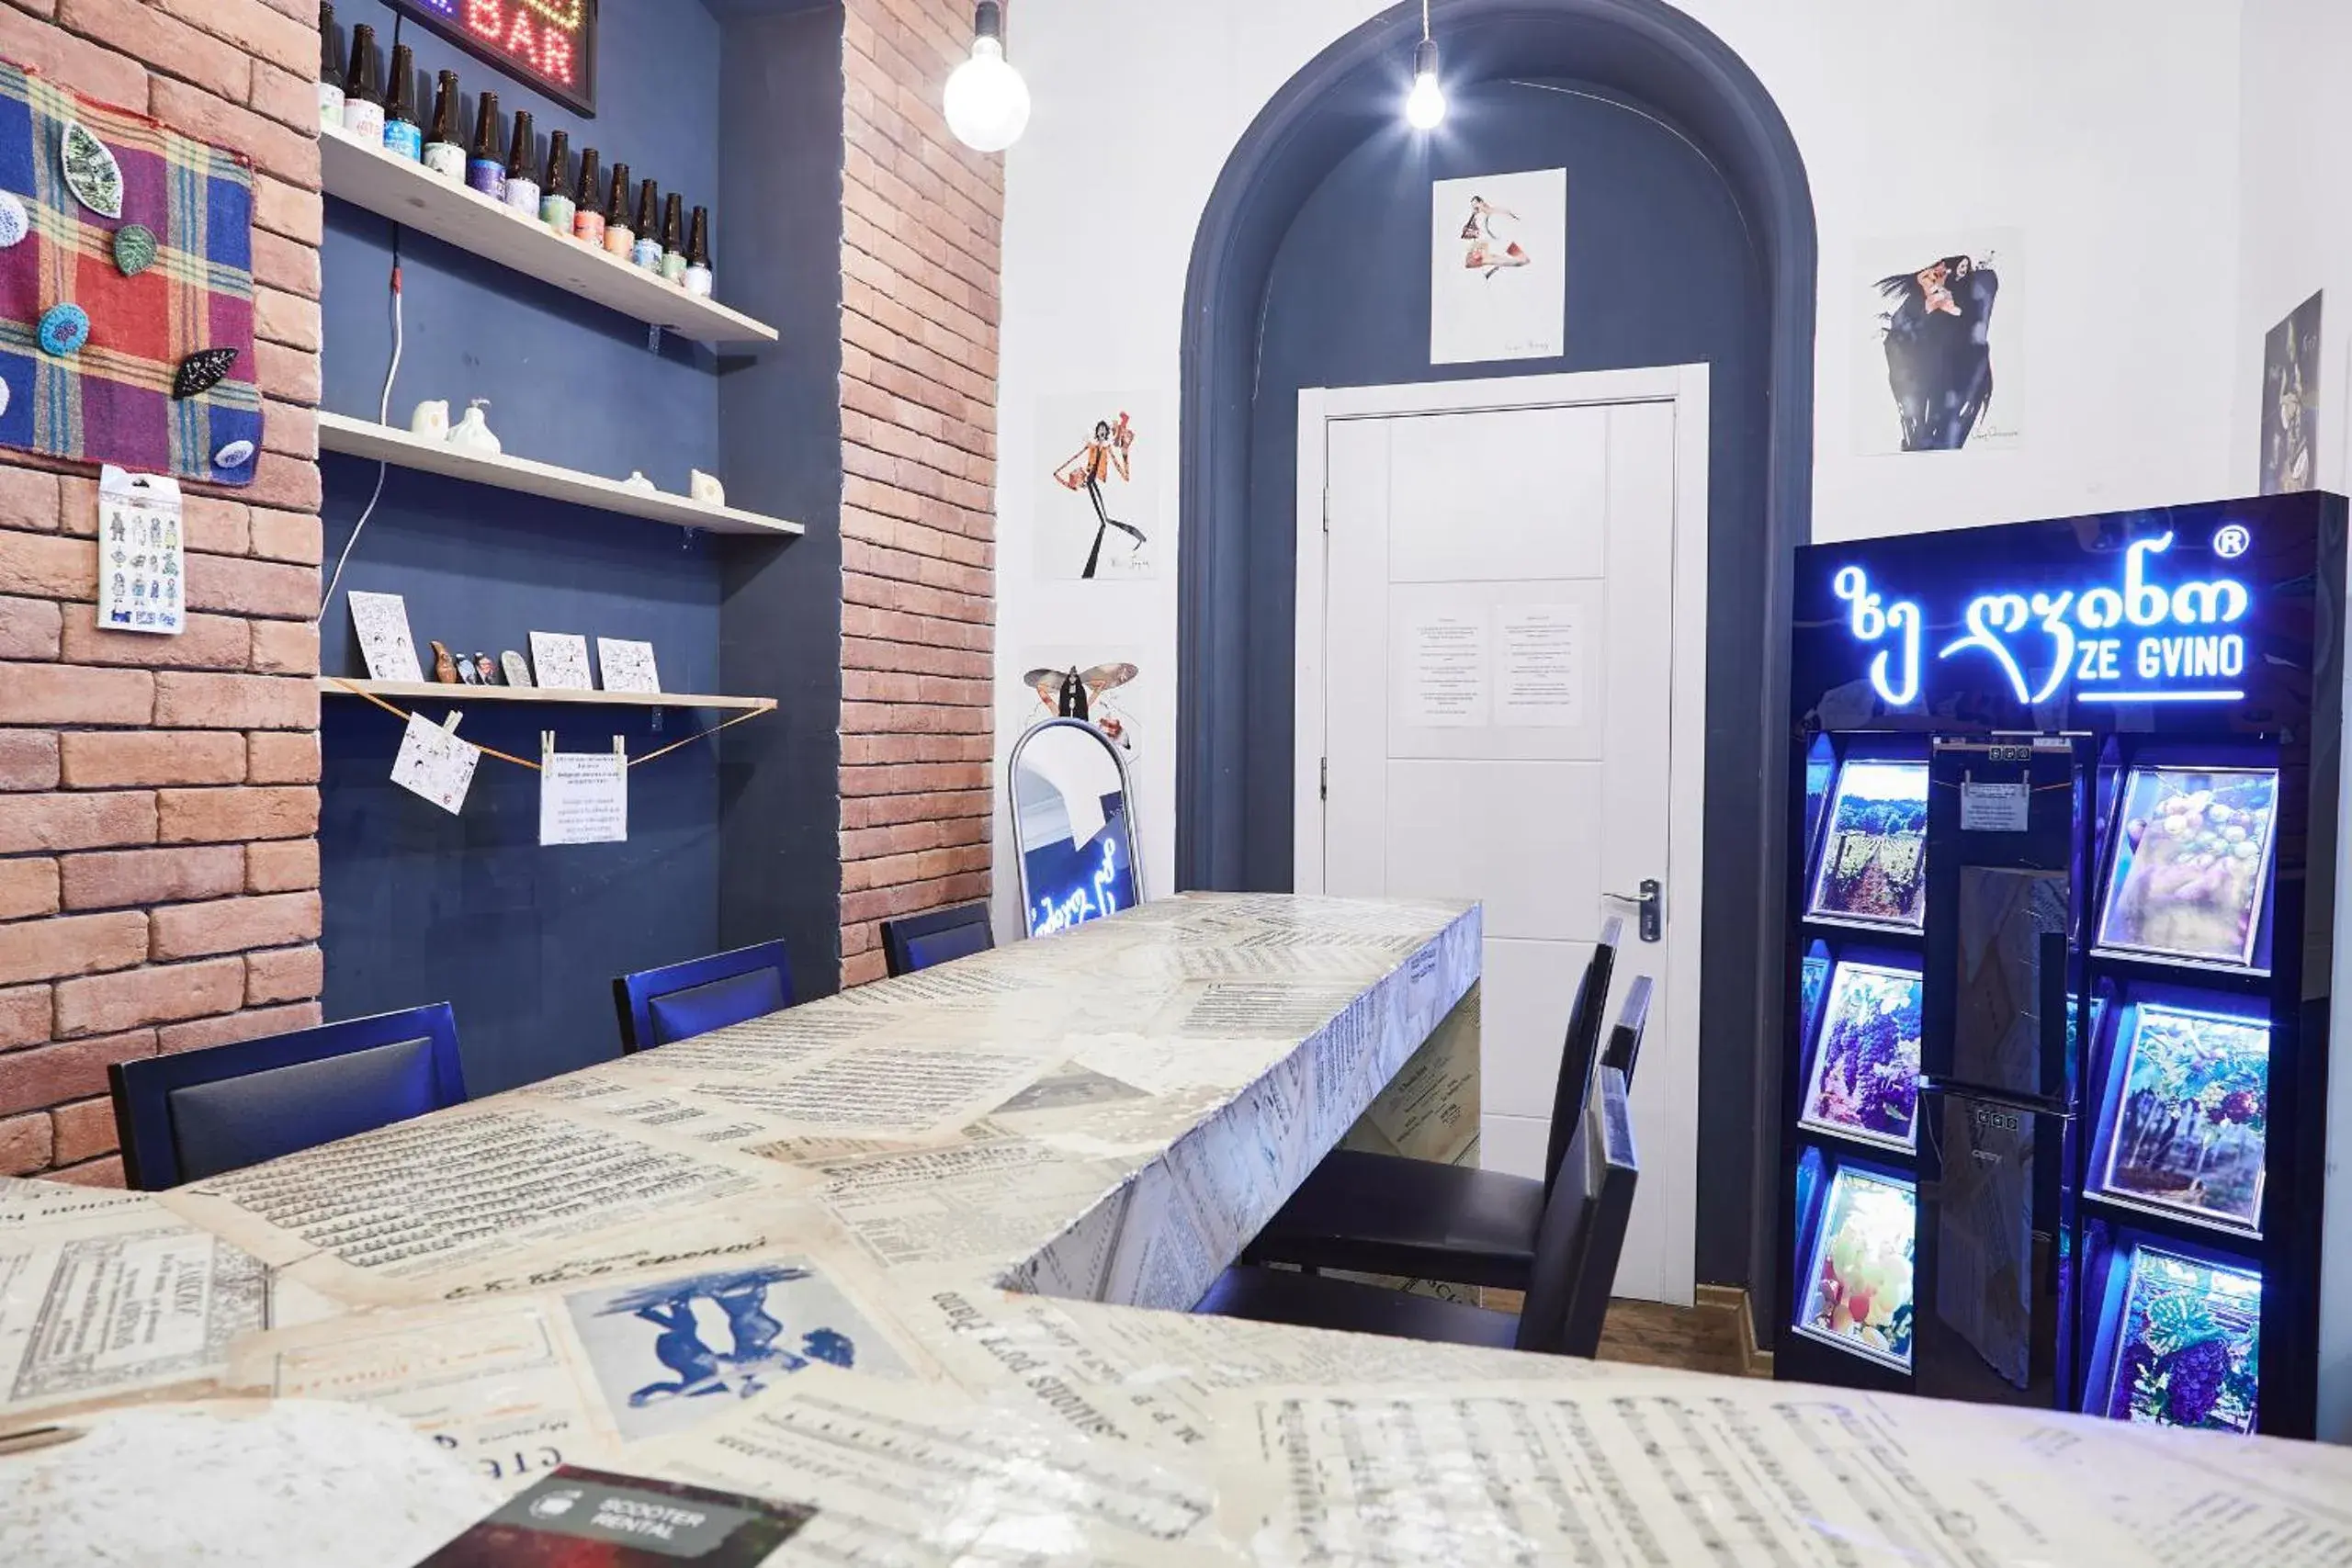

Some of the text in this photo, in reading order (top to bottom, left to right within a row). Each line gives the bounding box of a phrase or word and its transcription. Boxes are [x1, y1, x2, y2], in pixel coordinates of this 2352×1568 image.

[469, 0, 573, 85] BAR
[1834, 565, 1920, 705] ზე
[2076, 634, 2244, 680] ZE GVINO
[590, 1513, 677, 1540] RENTAL
[598, 1496, 707, 1528] SCOOTER
